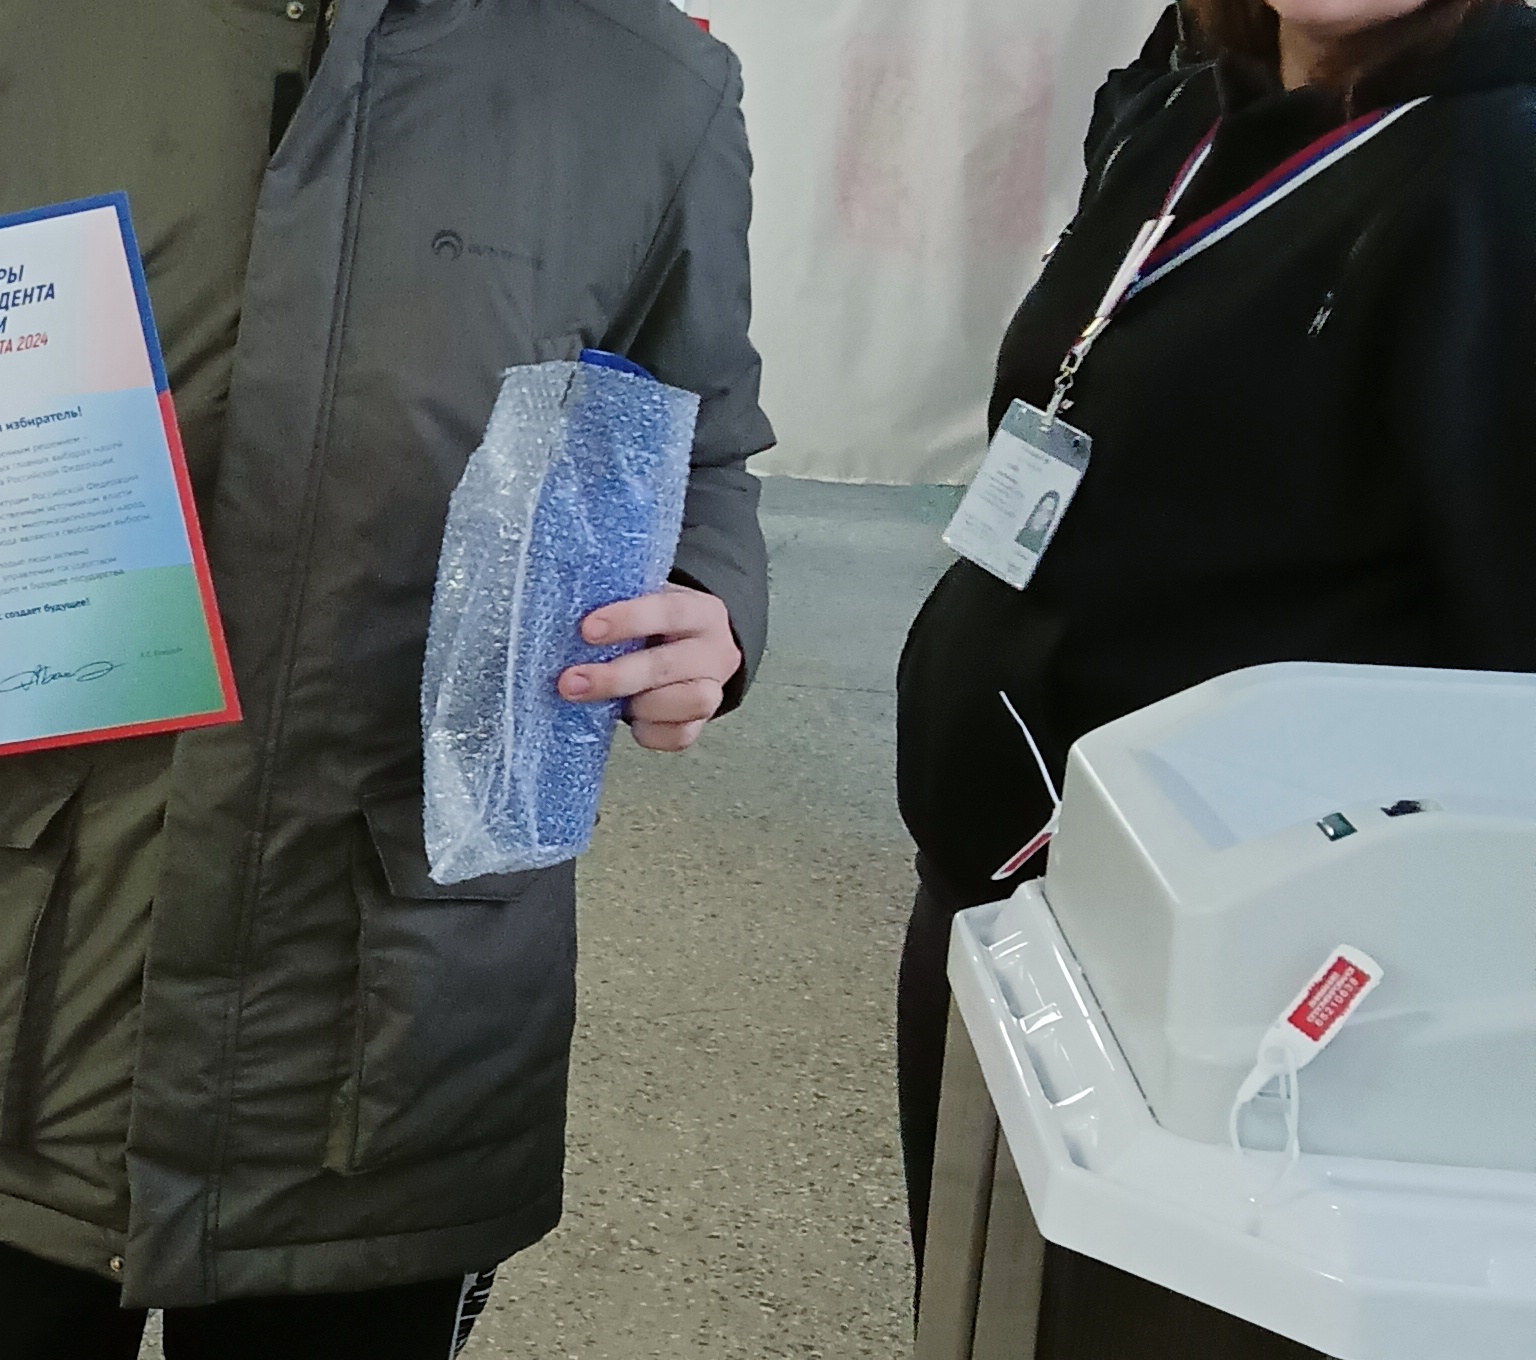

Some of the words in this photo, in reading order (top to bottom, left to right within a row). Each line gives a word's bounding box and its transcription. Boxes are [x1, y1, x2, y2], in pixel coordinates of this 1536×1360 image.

[16, 332, 50, 353] 2024
[4, 405, 83, 434] избиратель!
[3, 605, 42, 620] создает
[42, 595, 91, 614] будущее!
